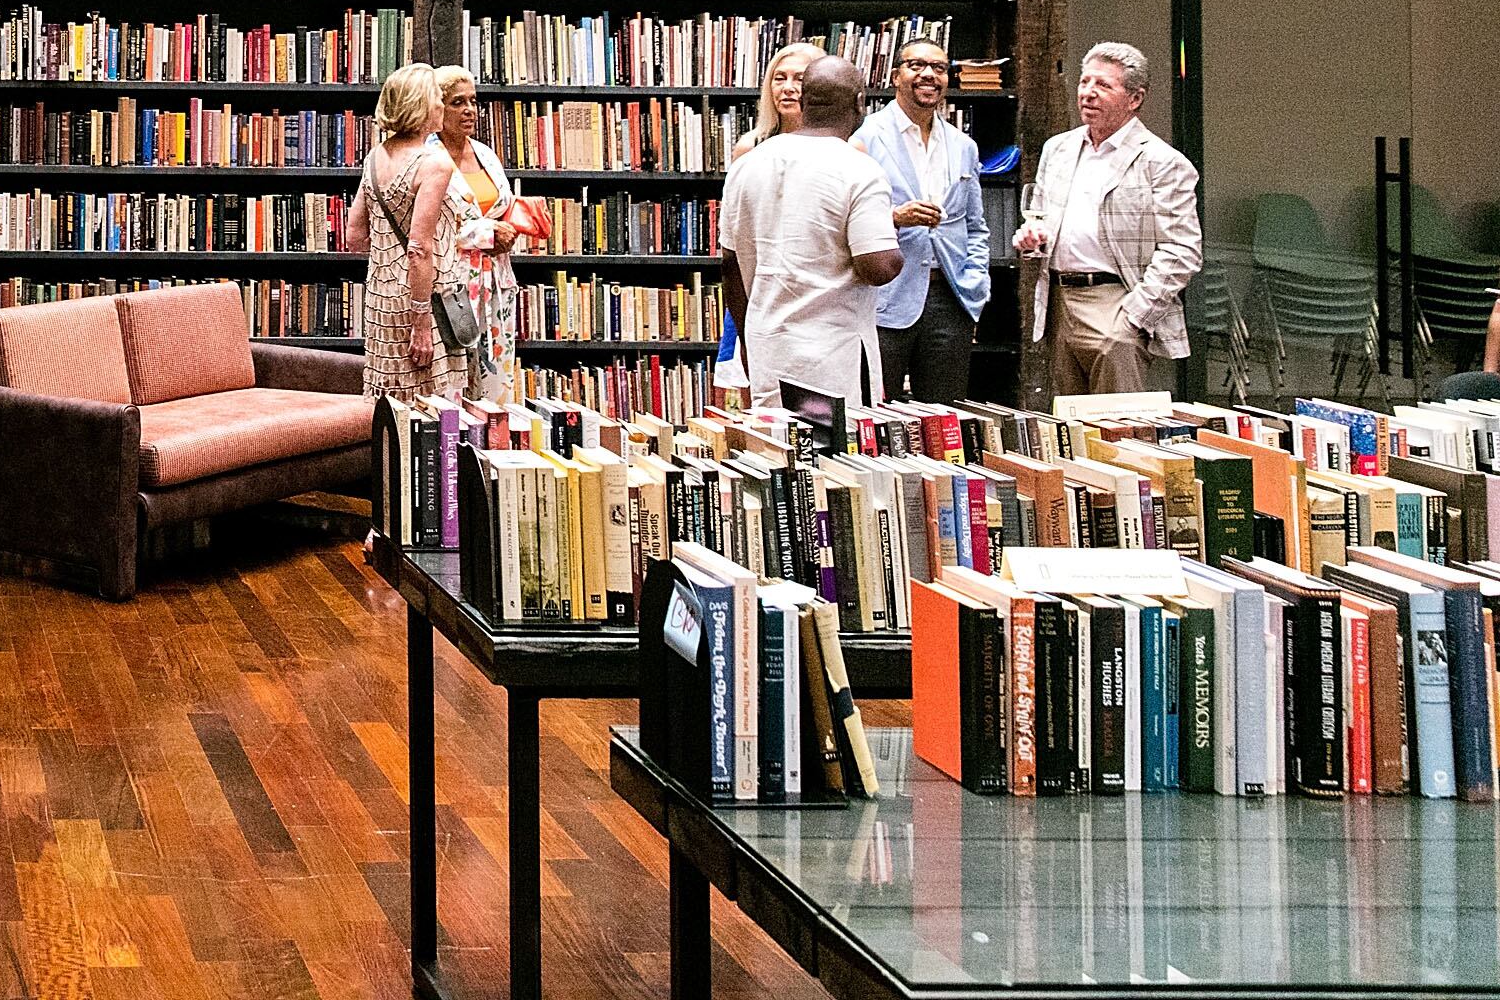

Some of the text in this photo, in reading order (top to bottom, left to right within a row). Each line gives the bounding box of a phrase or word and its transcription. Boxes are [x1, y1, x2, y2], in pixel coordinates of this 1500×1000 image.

[447, 450, 458, 469] Collins
[446, 503, 458, 520] Wives
[959, 493, 969, 514] Hope
[1079, 490, 1088, 522] WHERE
[630, 499, 639, 544] LIKE IT IS
[640, 510, 650, 545] Thunder
[650, 514, 661, 557] Speak Out
[776, 501, 791, 547] LIBERATING
[1048, 497, 1067, 546] Wayward
[1154, 504, 1165, 549] REVOLUTION
[812, 540, 820, 564] SOAR
[880, 513, 890, 569] STRUCTURALISM
[962, 531, 972, 559] Dignity
[1228, 547, 1237, 555] 61
[781, 549, 794, 578] VOICES
[1286, 619, 1294, 635] toni
[1320, 611, 1333, 637] AFRICAN
[742, 631, 750, 660] Writings
[1286, 637, 1294, 675] morrison
[1320, 640, 1334, 673] AMERICAN
[1354, 621, 1366, 661] finding
[1017, 673, 1031, 693] and
[1102, 661, 1112, 706] HUGHES
[1114, 647, 1123, 706] LANGSTON
[1321, 675, 1335, 704] LITERARY
[1357, 664, 1367, 685] fish
[712, 611, 731, 775] From the Dark Tower
[1194, 635, 1210, 748] Yeats MEMOIRS
[1321, 707, 1336, 739] CRITICISM
[1018, 736, 1033, 764] OUT
